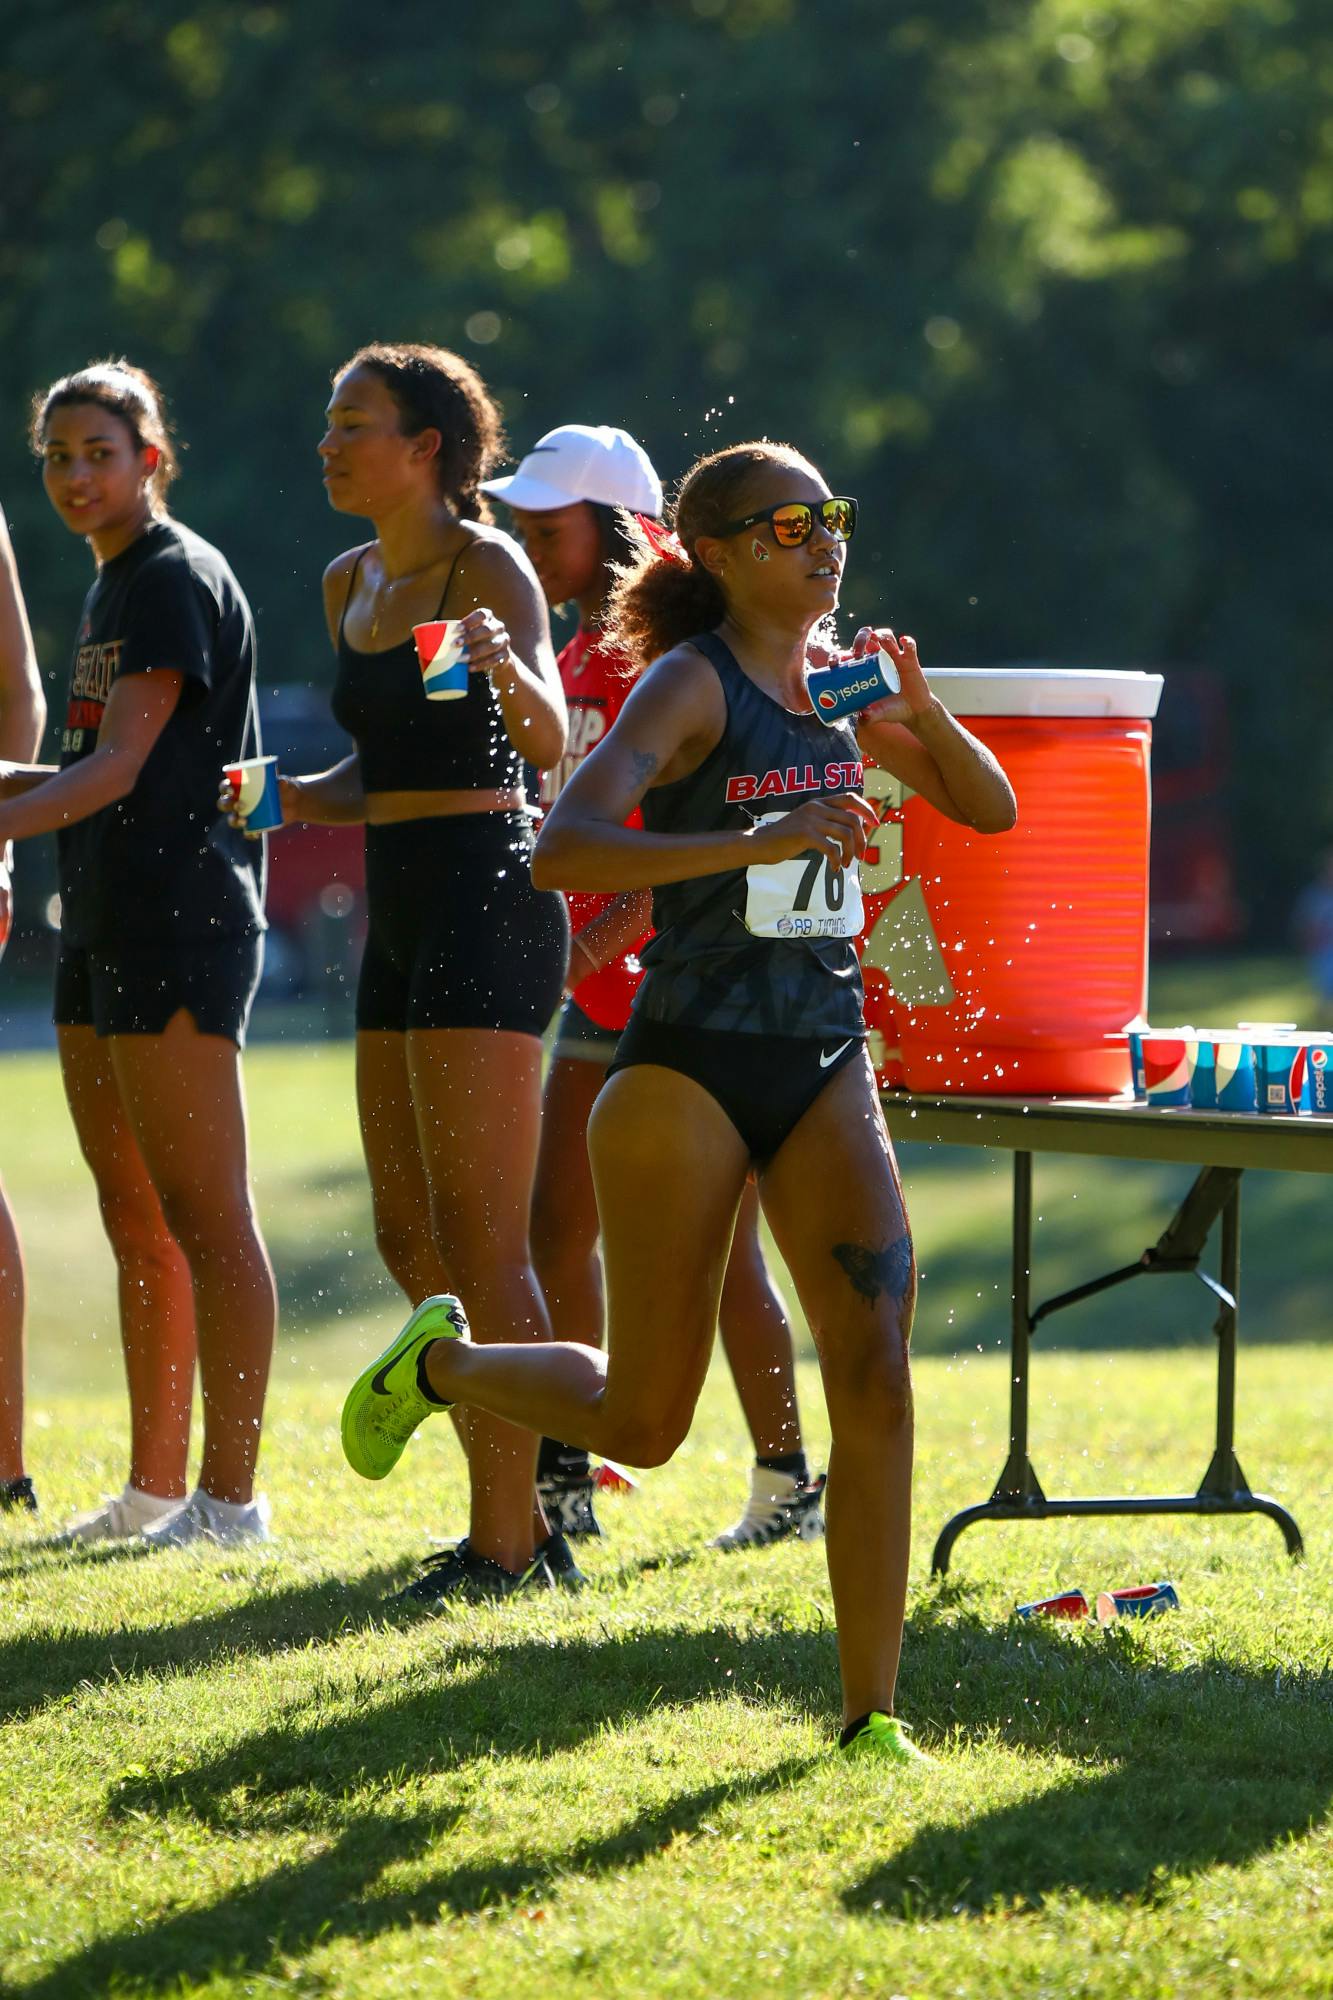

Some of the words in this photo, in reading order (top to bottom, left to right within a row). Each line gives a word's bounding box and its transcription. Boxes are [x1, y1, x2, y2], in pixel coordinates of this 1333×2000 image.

[840, 674, 879, 701] pepsi
[725, 765, 821, 803] BALL
[1314, 1068, 1326, 1108] pepsi
